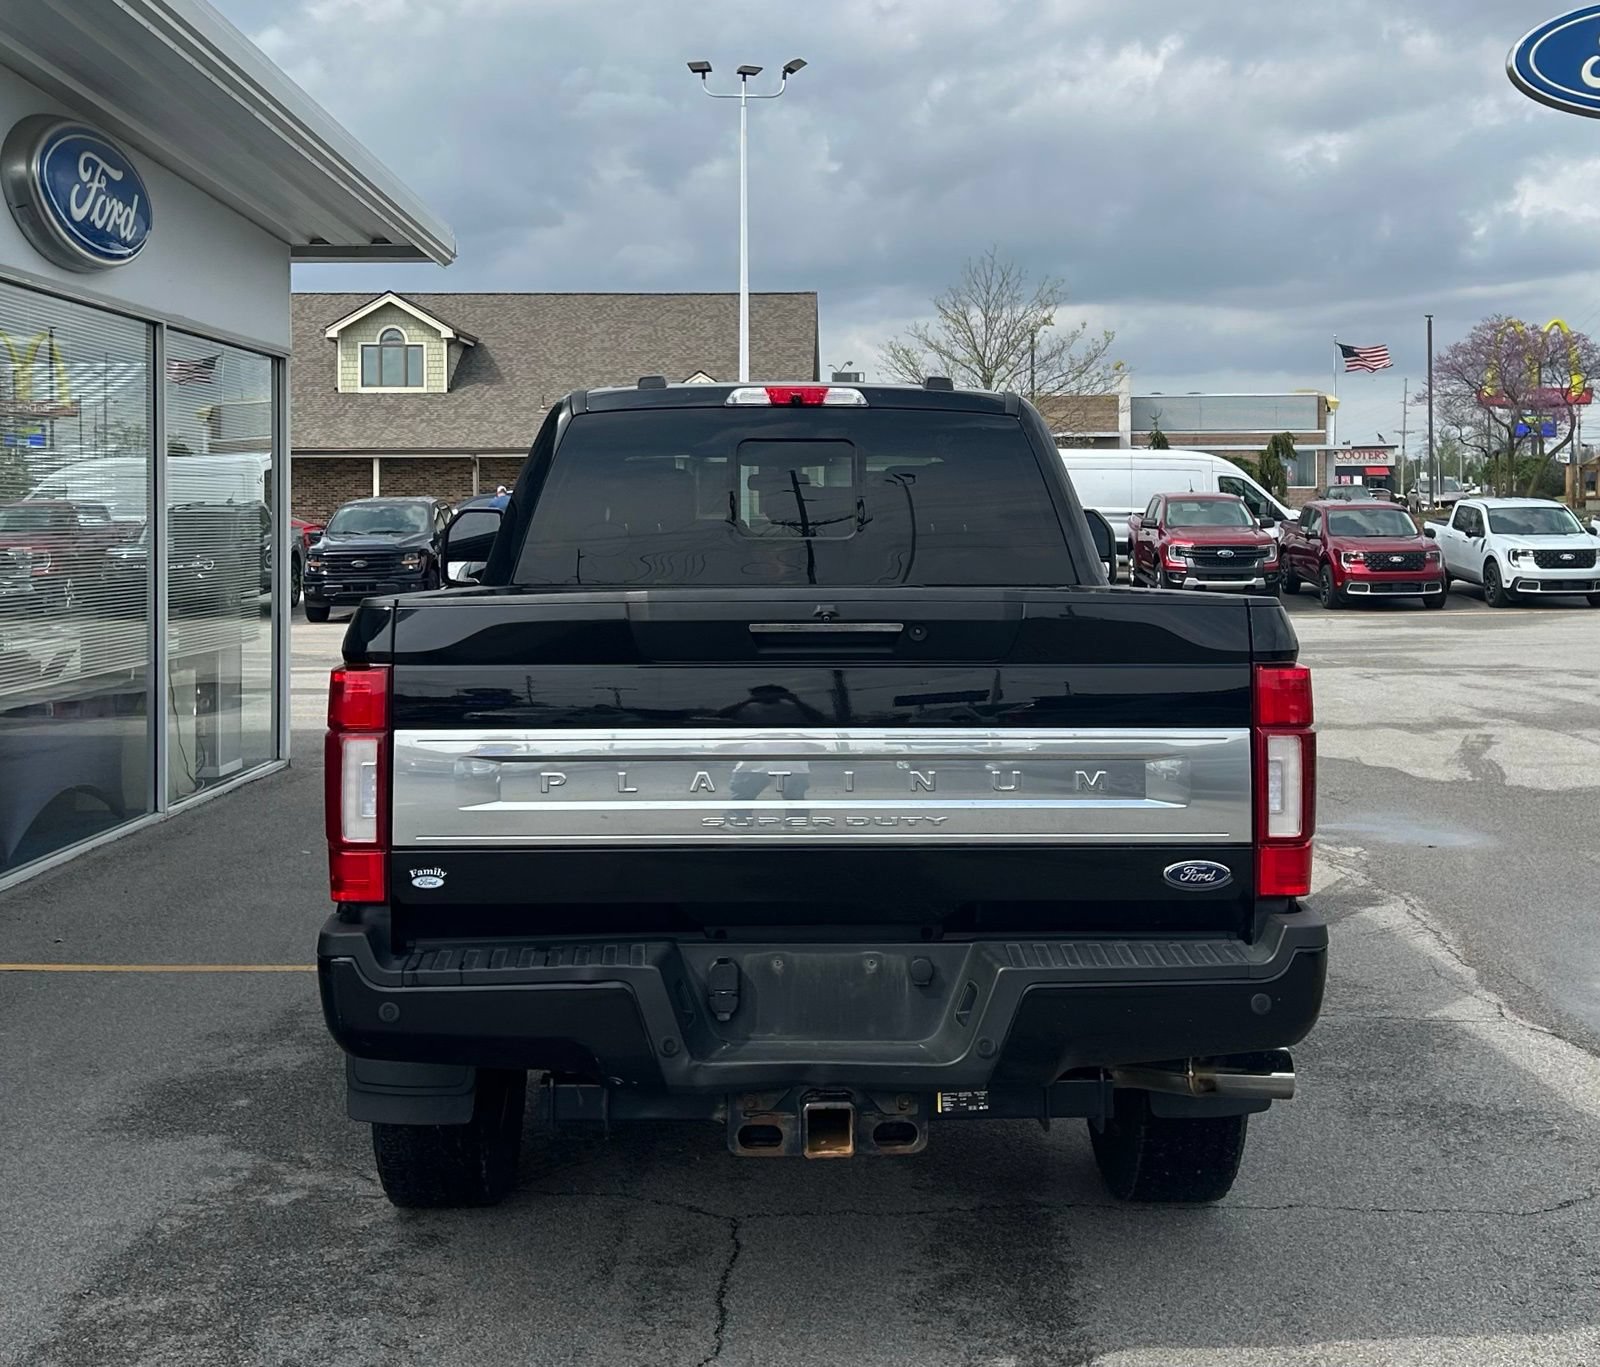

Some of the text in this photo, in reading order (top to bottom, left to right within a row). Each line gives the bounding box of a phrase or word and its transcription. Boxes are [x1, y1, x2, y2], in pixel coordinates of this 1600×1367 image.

[70, 151, 139, 242] Ford
[540, 770, 1107, 793] PLATINUM
[702, 815, 949, 828] SUPER DUTY
[409, 867, 447, 878] Family
[1180, 866, 1216, 881] Ford
